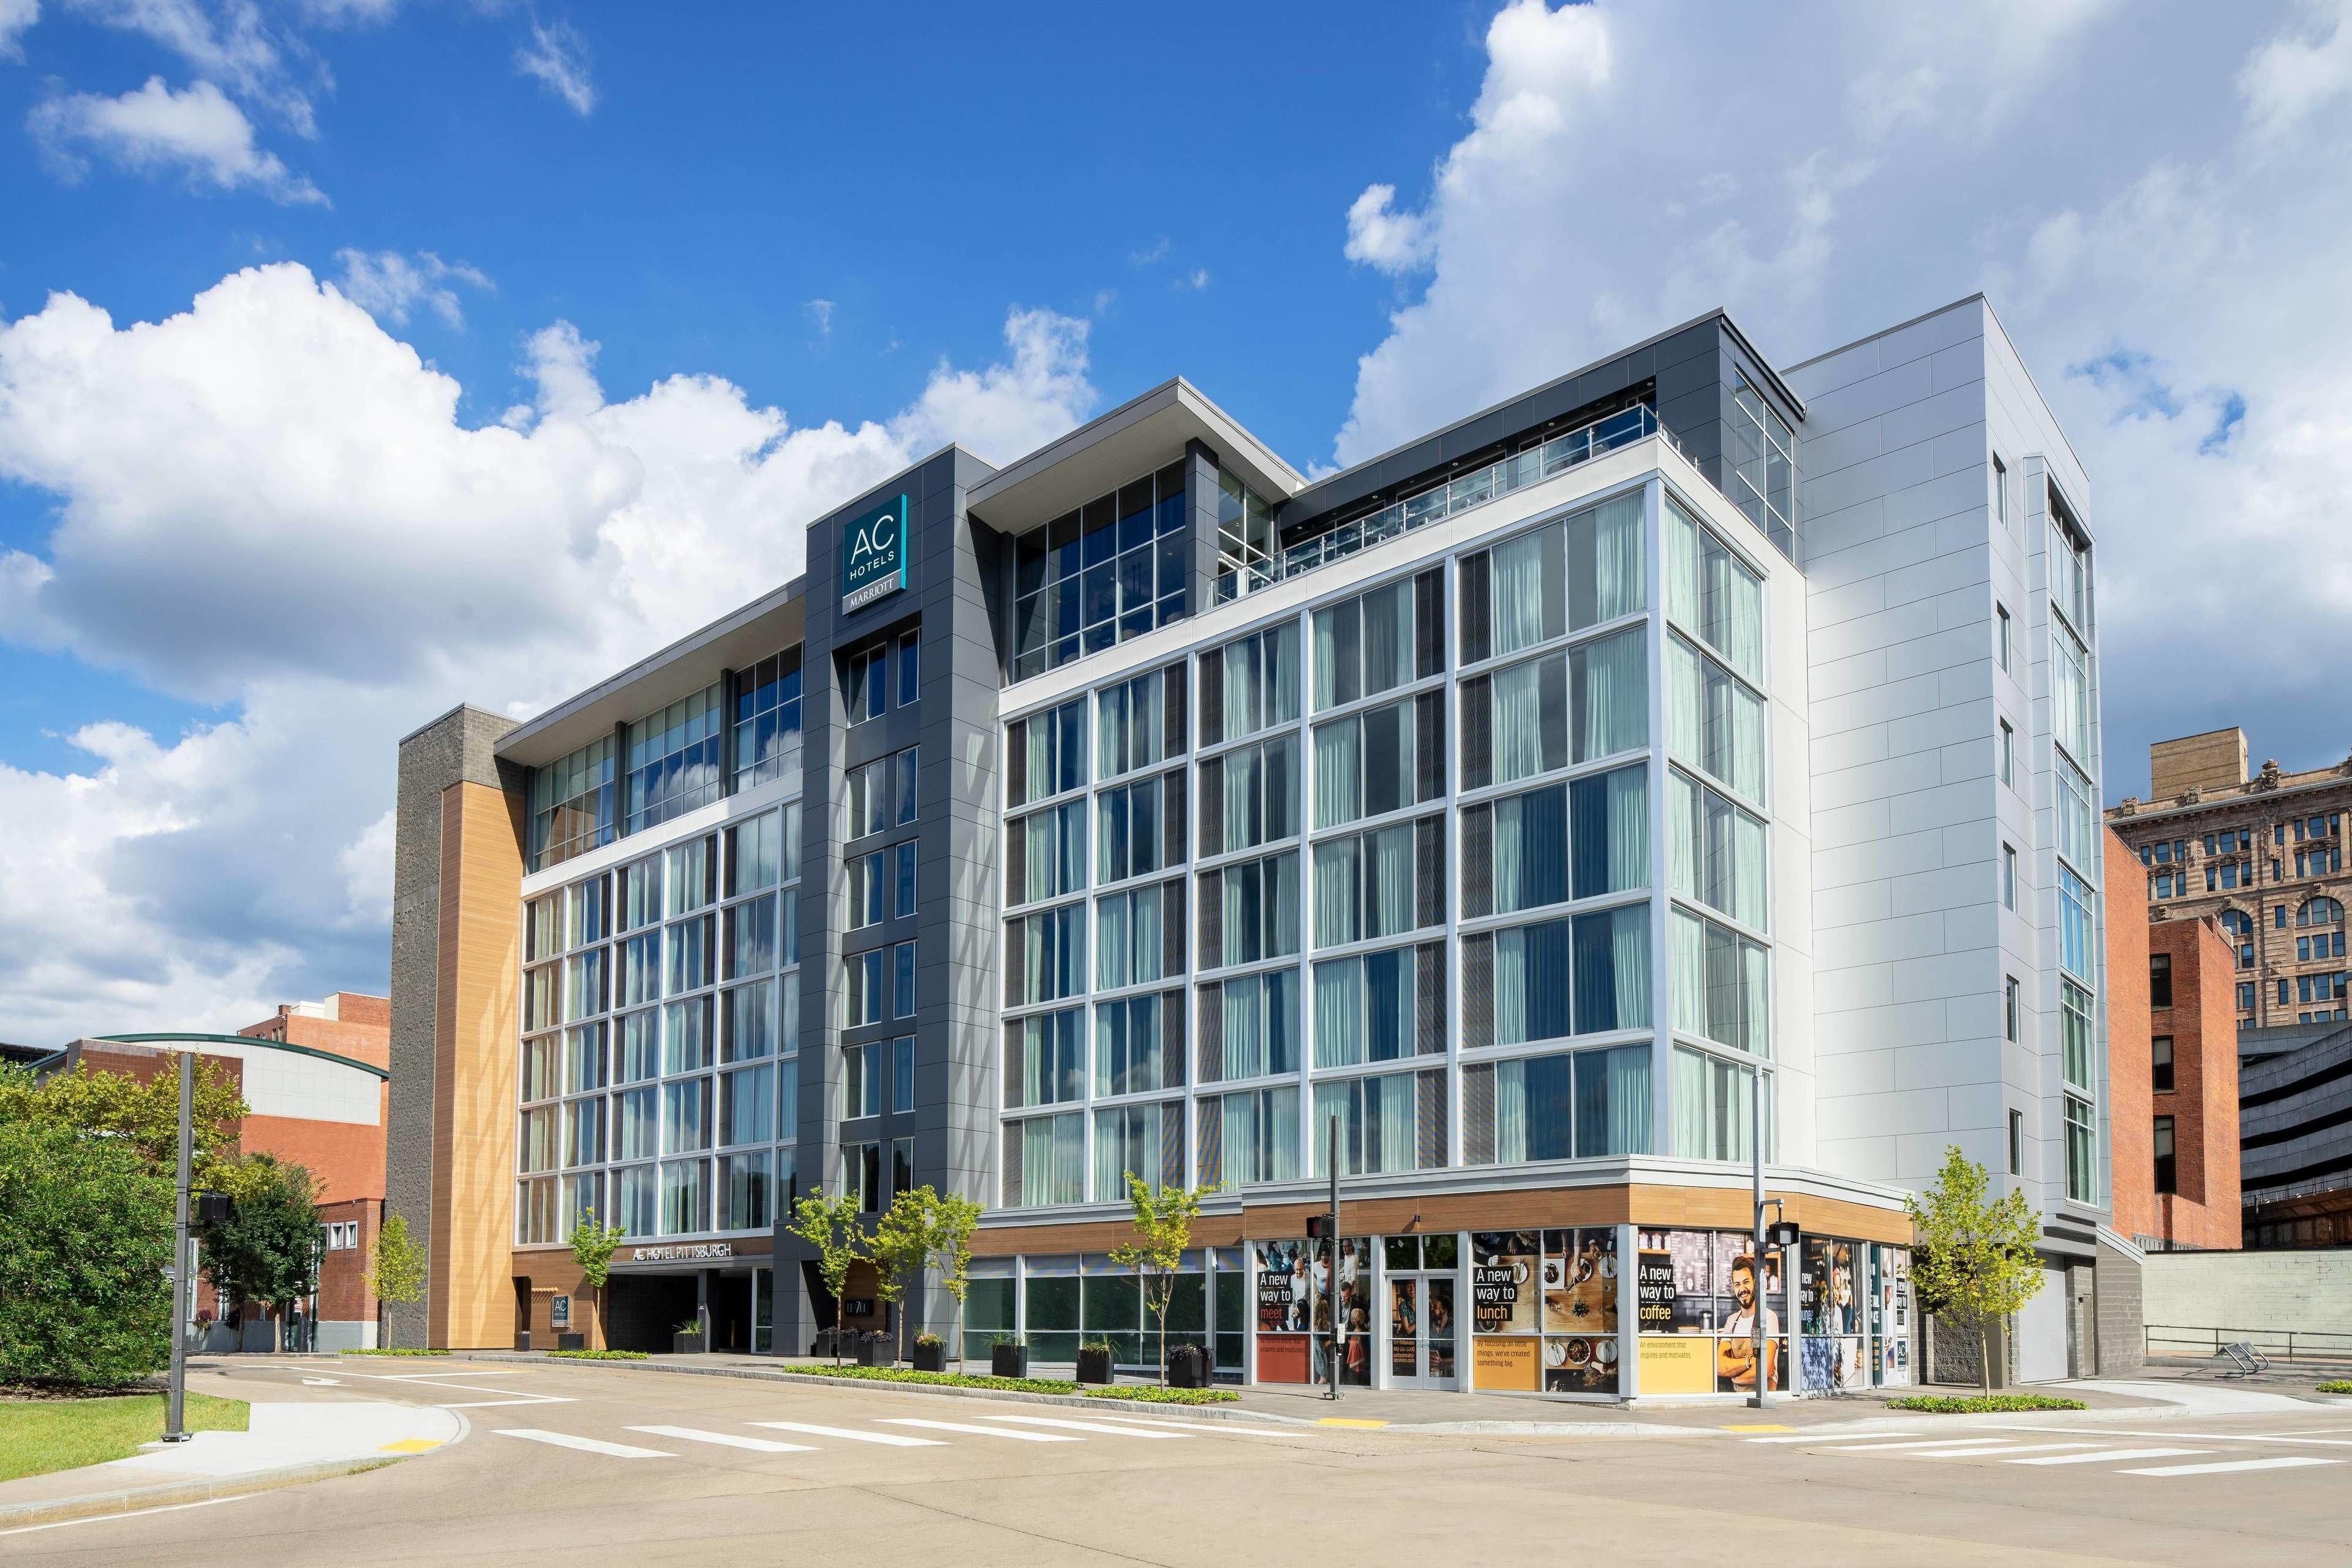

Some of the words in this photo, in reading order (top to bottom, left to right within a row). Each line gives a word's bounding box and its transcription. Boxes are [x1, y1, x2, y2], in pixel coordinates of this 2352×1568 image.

[851, 514, 894, 565] AC
[850, 551, 894, 581] HOTELS
[850, 578, 894, 608] MARRIOTT
[632, 1248, 646, 1261] AC
[646, 1246, 674, 1260] HOTEL
[676, 1243, 731, 1259] PITTSBURGH
[1260, 1273, 1267, 1286] A
[1269, 1275, 1288, 1286] new
[1476, 1268, 1485, 1282] A
[1488, 1270, 1511, 1282] new
[1640, 1265, 1648, 1280] A
[1650, 1267, 1672, 1280] new
[1801, 1273, 1812, 1284] new
[1260, 1290, 1279, 1303] way
[1281, 1289, 1291, 1301] to
[1477, 1288, 1500, 1302] way
[1502, 1286, 1515, 1300] to
[1640, 1286, 1661, 1301] way
[1664, 1284, 1675, 1299] to
[1808, 1289, 1813, 1302] to
[554, 1300, 567, 1311] AC
[1477, 1305, 1507, 1319] lunch
[1640, 1305, 1671, 1320] coffee
[1261, 1308, 1283, 1319] meet
